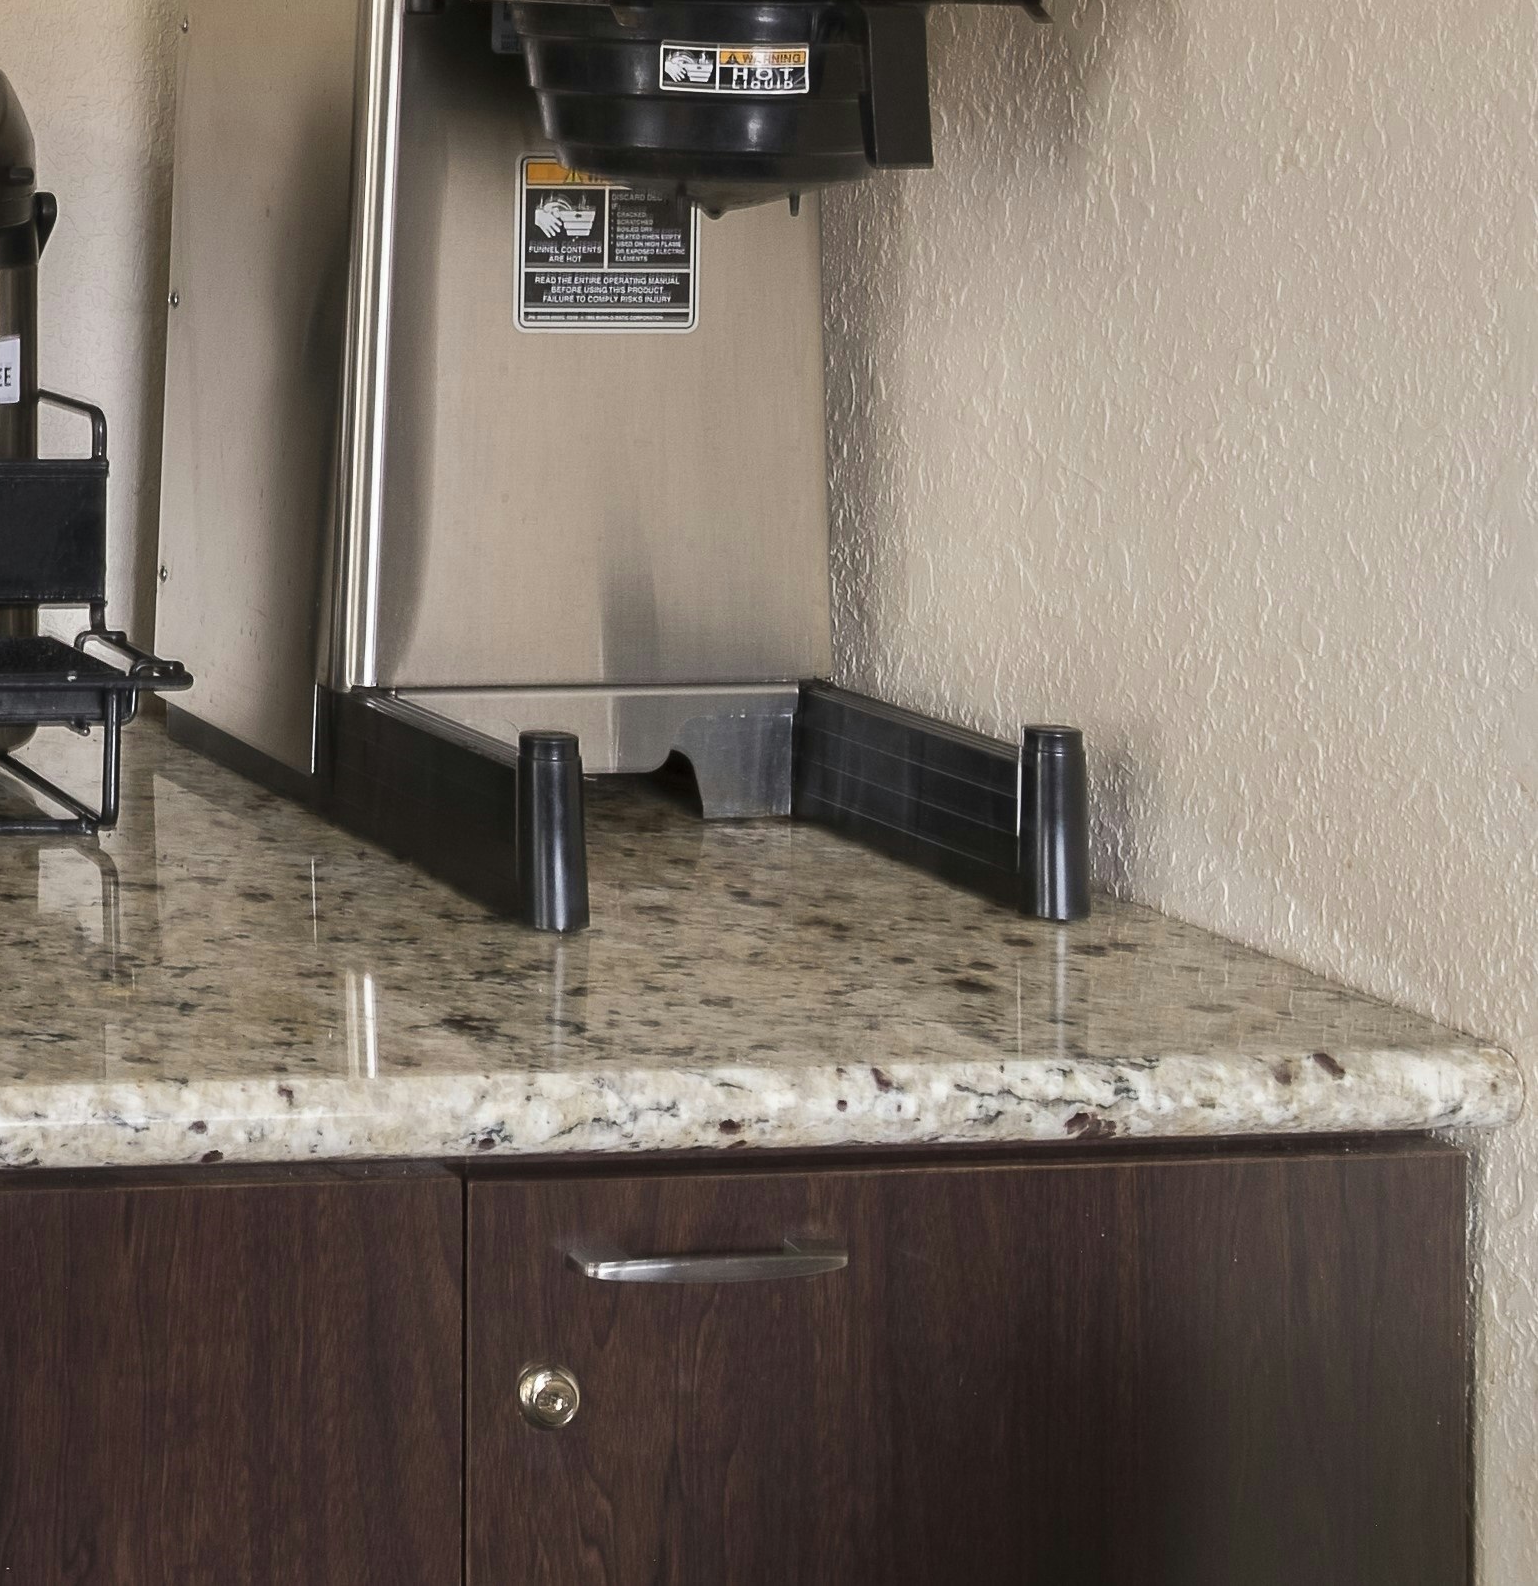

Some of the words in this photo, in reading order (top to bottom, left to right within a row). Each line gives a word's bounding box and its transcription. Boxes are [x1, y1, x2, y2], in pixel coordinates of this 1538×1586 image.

[733, 67, 794, 81] HOT
[732, 80, 794, 90] LIQUID
[611, 193, 645, 201] DISCARD
[528, 246, 560, 254] FUNNEL
[561, 246, 602, 254] CONTENTS
[548, 255, 565, 263] ARE
[566, 255, 582, 263] HOT
[535, 276, 556, 284] READ
[557, 276, 572, 284] THE
[574, 276, 601, 285] ENTIRE
[603, 276, 647, 285] OPERATING
[648, 276, 680, 285] MANUAL
[551, 286, 582, 294] BEFORE
[584, 286, 607, 294] USING
[609, 286, 625, 294] THIS
[627, 286, 663, 294] PRODUCT
[542, 295, 574, 303] FAILURE
[576, 295, 586, 303] TO
[587, 295, 618, 303] COMPLY
[620, 295, 643, 303] RISKS
[644, 295, 671, 303] INJURY
